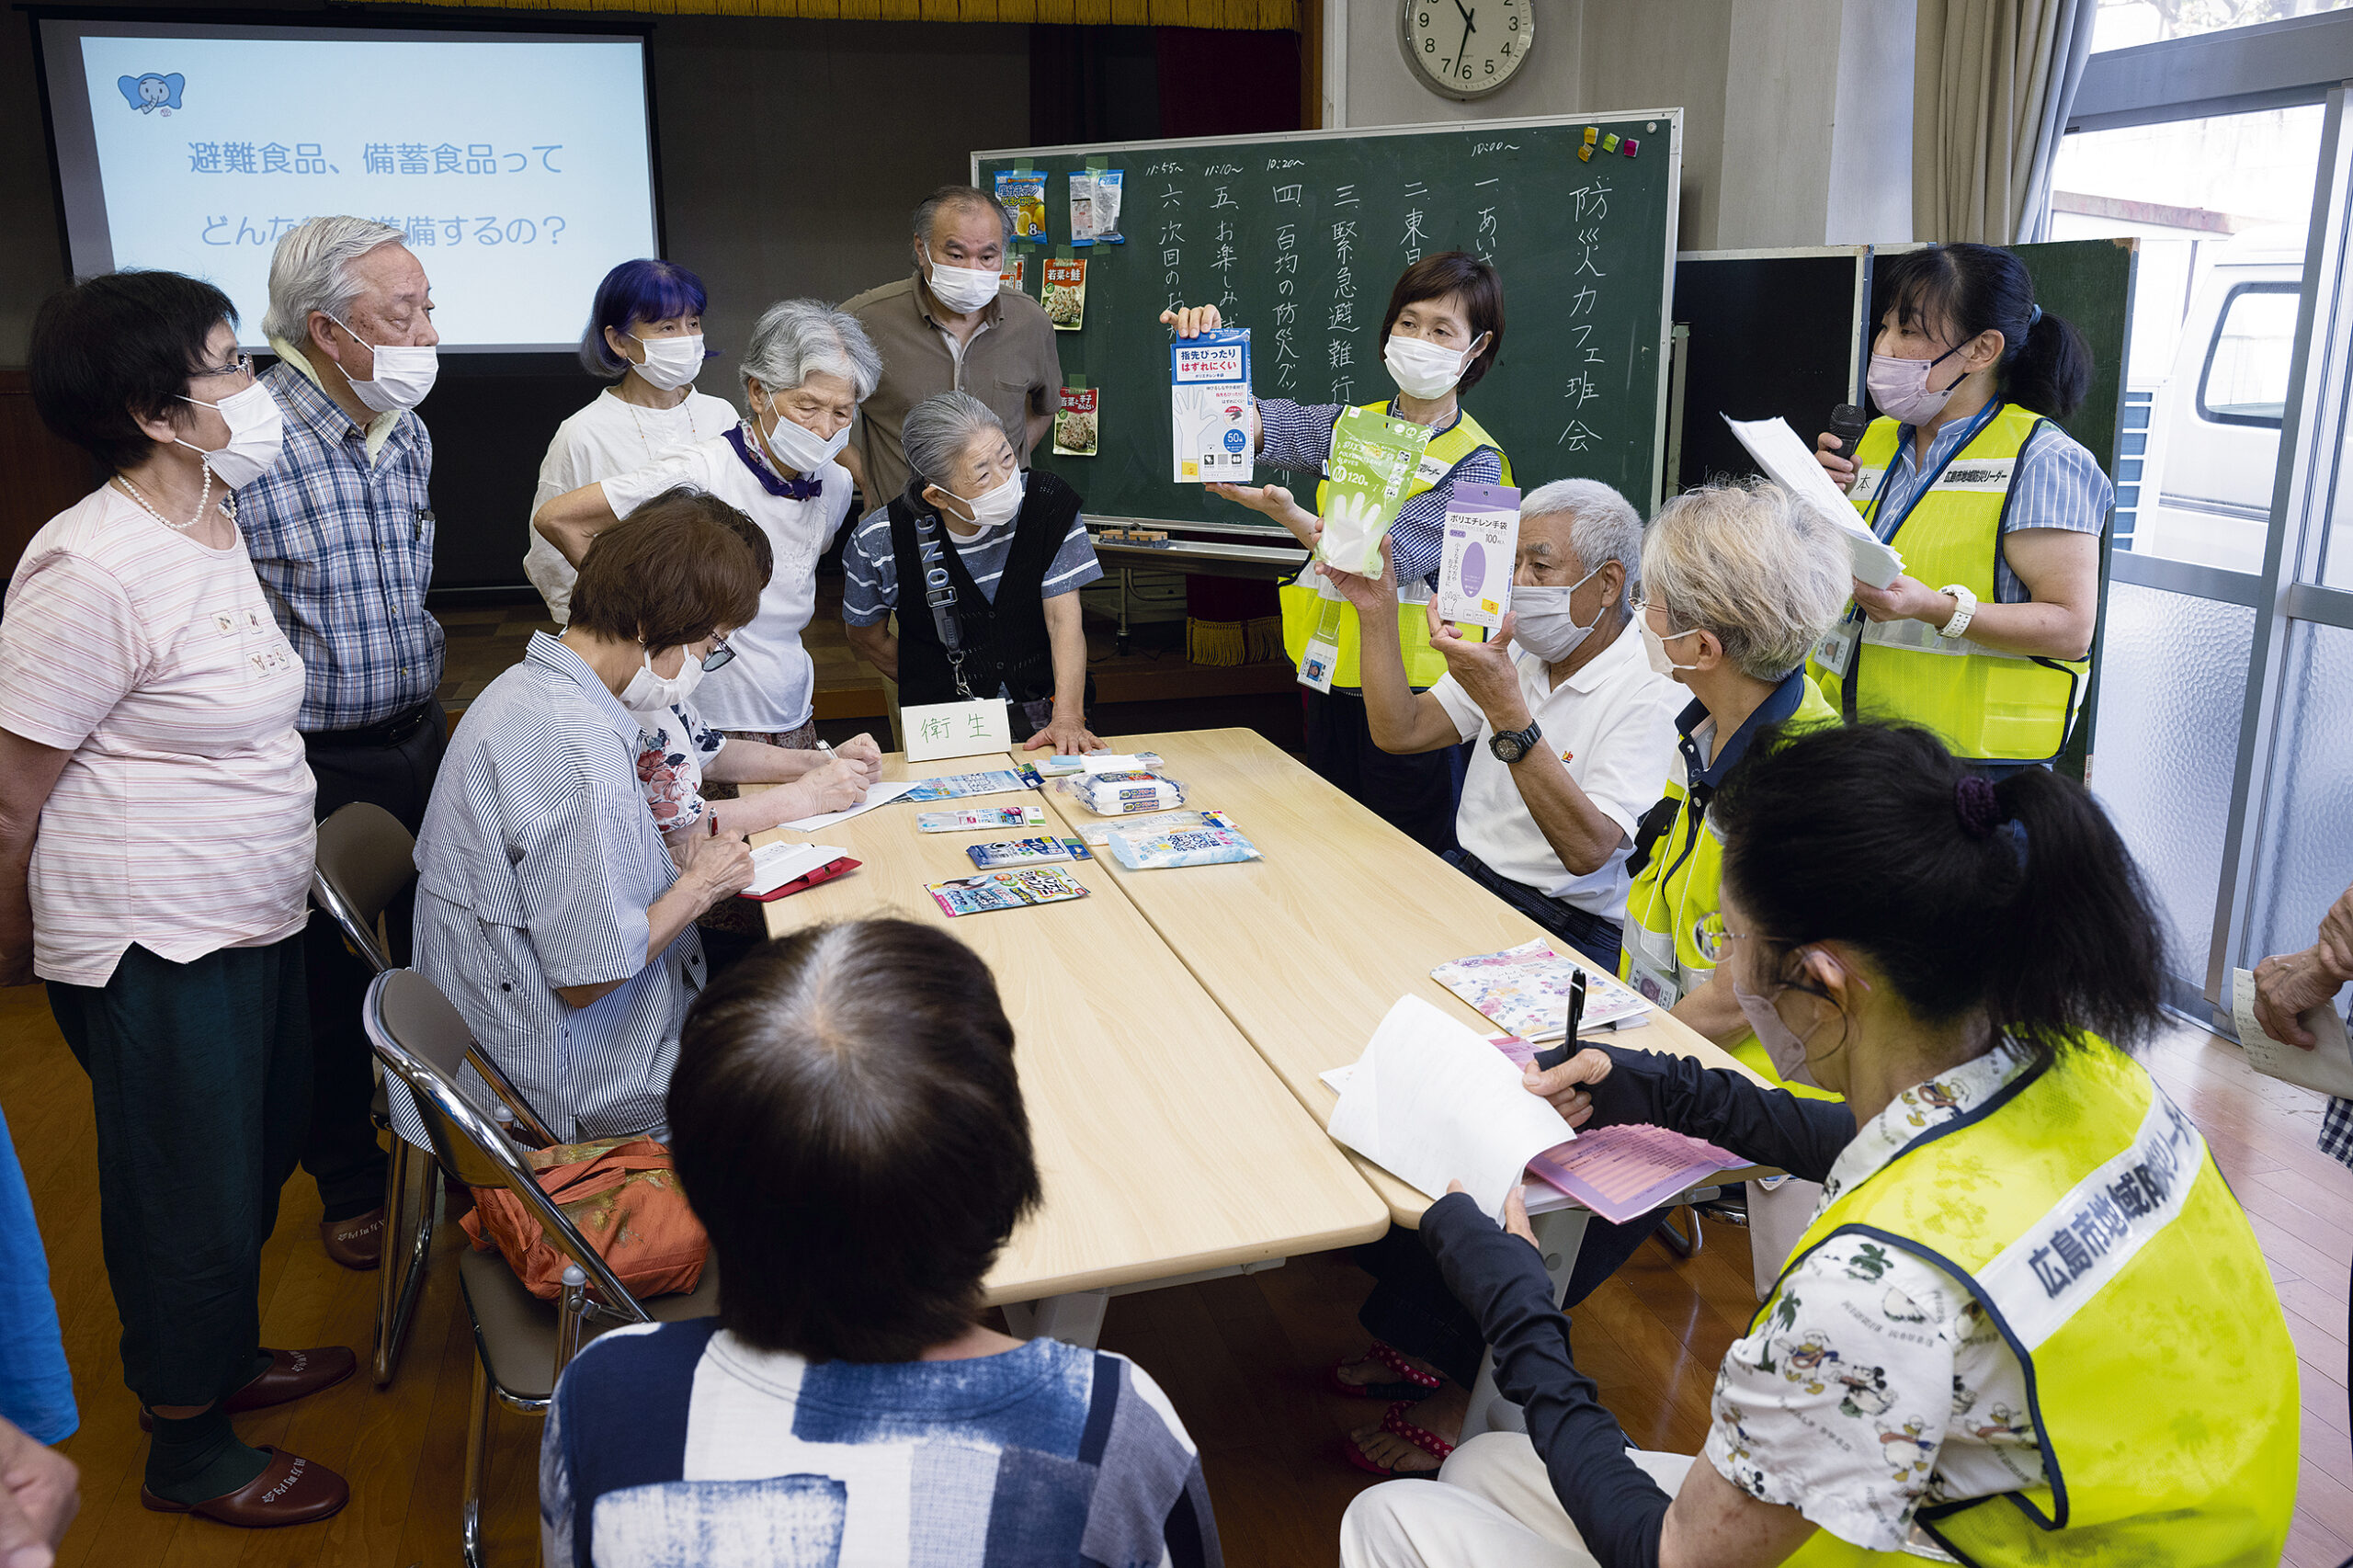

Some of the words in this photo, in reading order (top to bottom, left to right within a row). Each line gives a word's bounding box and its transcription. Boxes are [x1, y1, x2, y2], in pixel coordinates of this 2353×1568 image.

[1418, 12, 1430, 28] 9
[1508, 16, 1519, 31] 3
[1424, 38, 1436, 53] 8
[1500, 41, 1512, 57] 4
[1440, 58, 1451, 74] 7
[1461, 64, 1472, 80] 6
[1483, 59, 1495, 74] 5
[188, 141, 564, 176] 避難食品、備蓄食品って
[1557, 176, 1613, 453] 防災カフェ班会
[1181, 360, 1237, 372] はずれにくい
[1449, 514, 1508, 530] ポリエチレン手袋
[919, 711, 993, 744] 衛生
